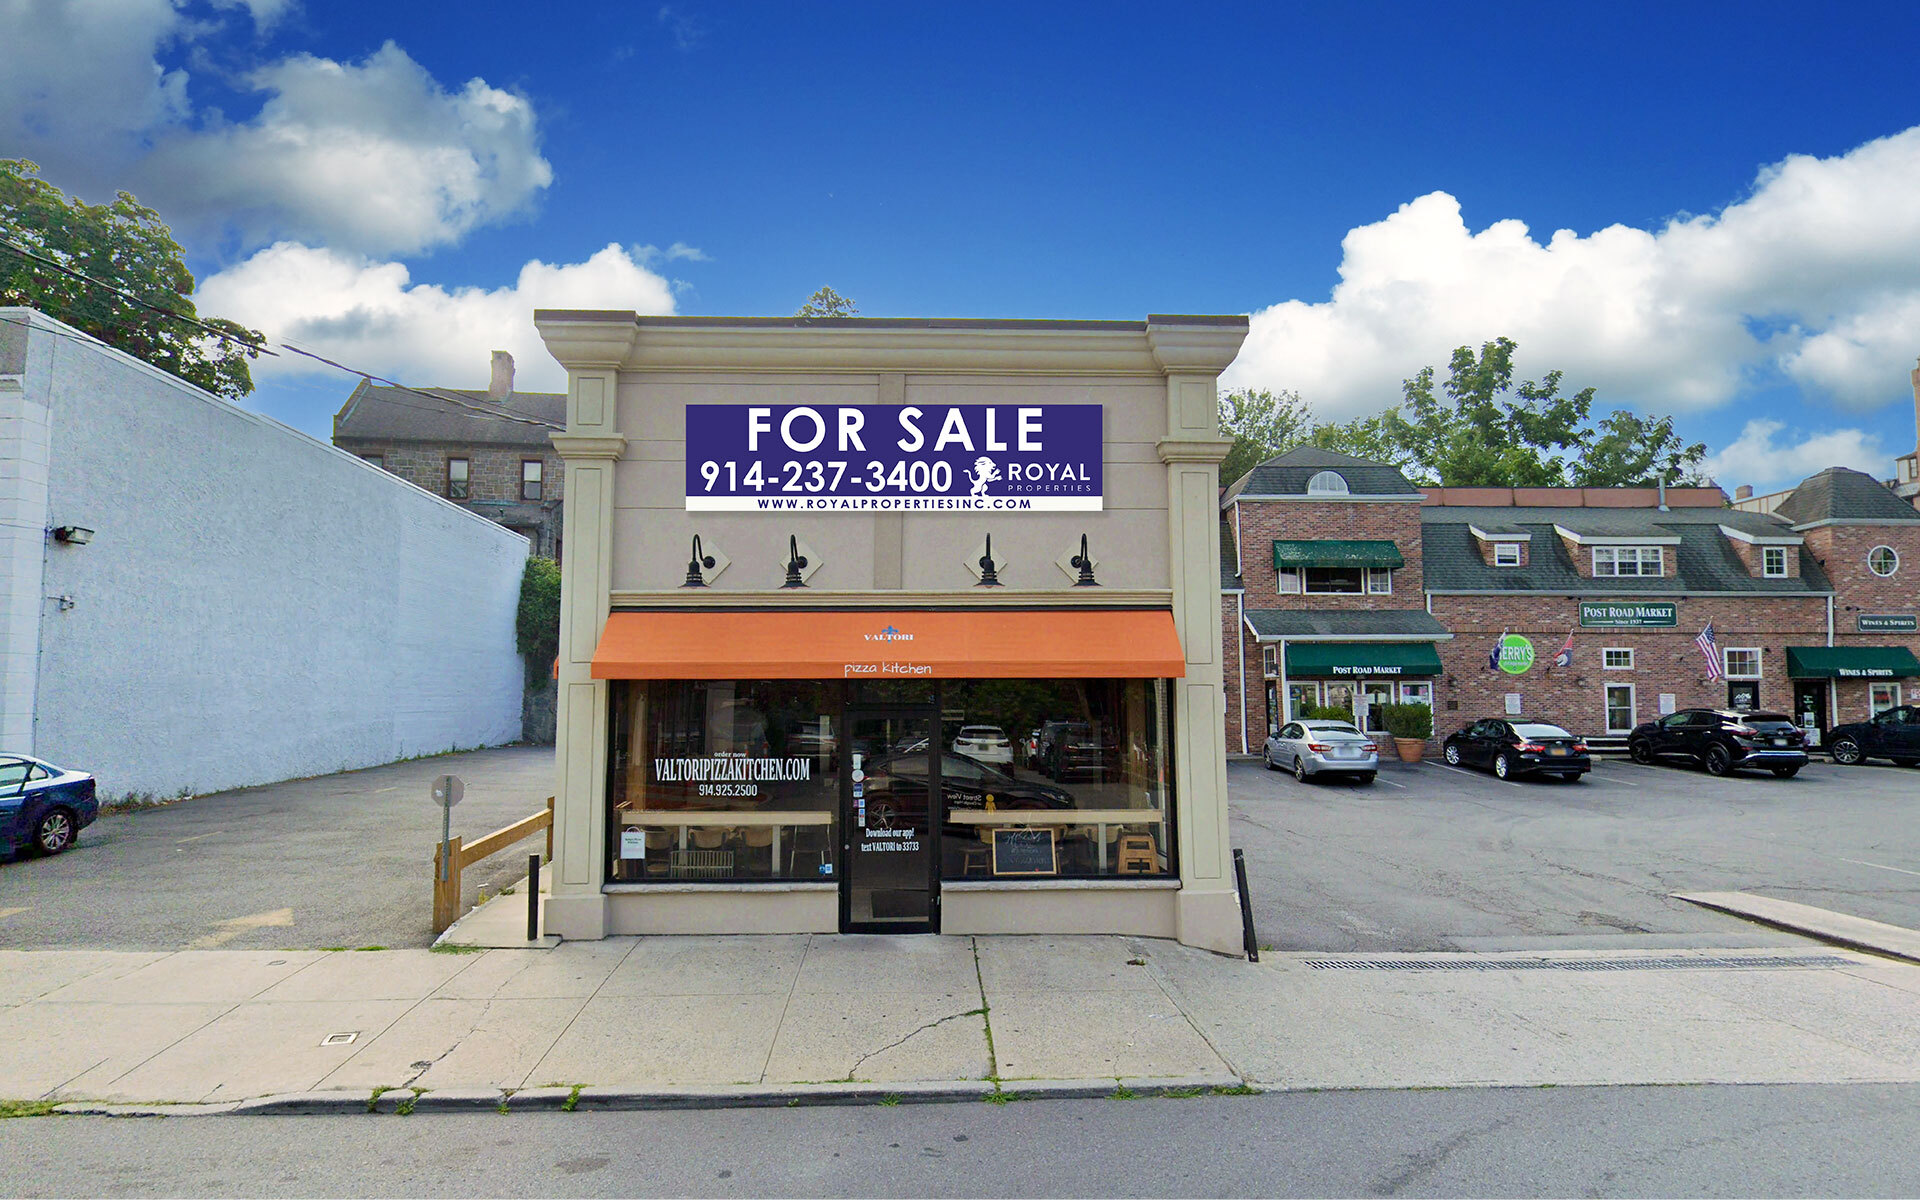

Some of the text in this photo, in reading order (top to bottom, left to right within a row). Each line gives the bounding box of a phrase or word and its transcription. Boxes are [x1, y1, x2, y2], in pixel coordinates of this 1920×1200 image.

[747, 406, 1043, 452] FOR SALE
[700, 460, 953, 493] 914-237-3400
[1007, 463, 1092, 481] ROYAL
[1007, 484, 1092, 492] PROPERTIES
[757, 498, 1032, 509] WWW.ROYALPROPERTIESINC.COM
[844, 661, 932, 678] pizza kitchen
[655, 758, 810, 781] VALTORIPIZZAKITCHEN.COM
[698, 784, 758, 797] 914.925.2500
[865, 827, 915, 839] Download our app!
[861, 842, 919, 852] text VALTORI to 33733
